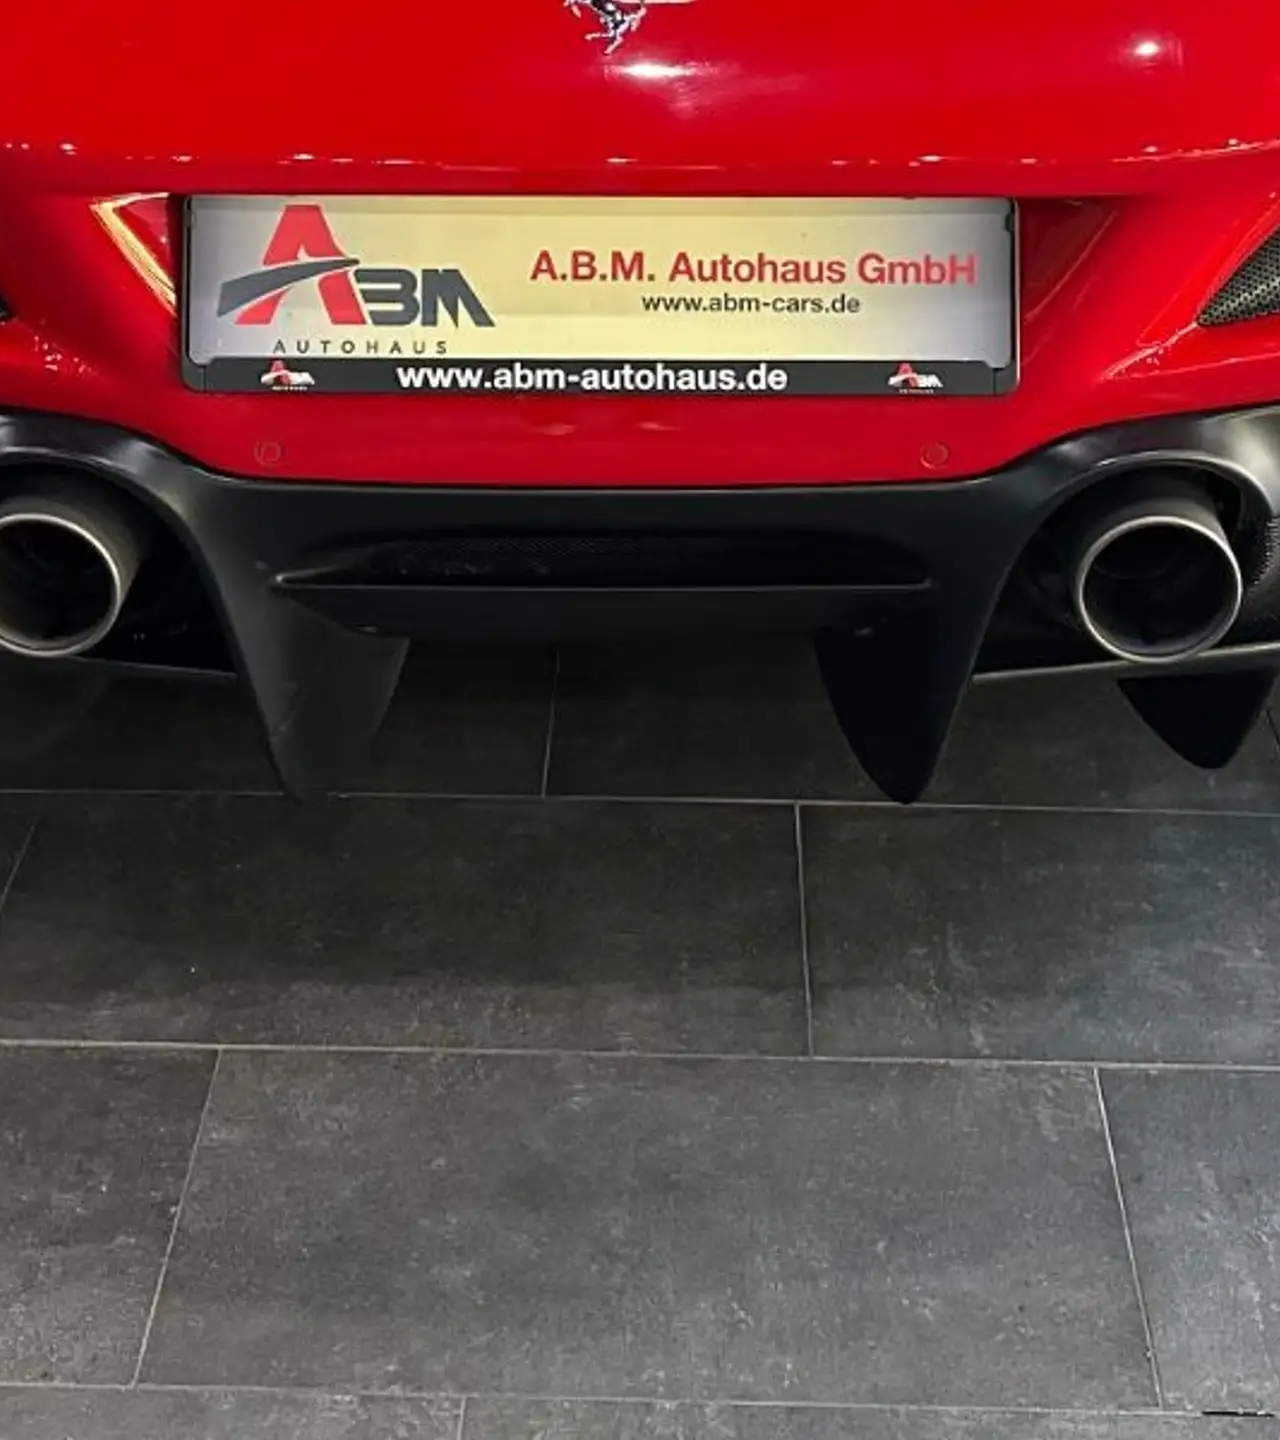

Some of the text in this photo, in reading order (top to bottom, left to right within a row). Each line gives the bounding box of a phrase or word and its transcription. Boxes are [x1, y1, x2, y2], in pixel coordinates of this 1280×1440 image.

[217, 203, 496, 328] ABM
[529, 250, 978, 286] A.B.M. Autohaus GmbH
[641, 292, 861, 314] www.abm-cars.de
[272, 340, 449, 355] AUTOHAUS
[395, 363, 789, 391] www.abm-autohaus.de
